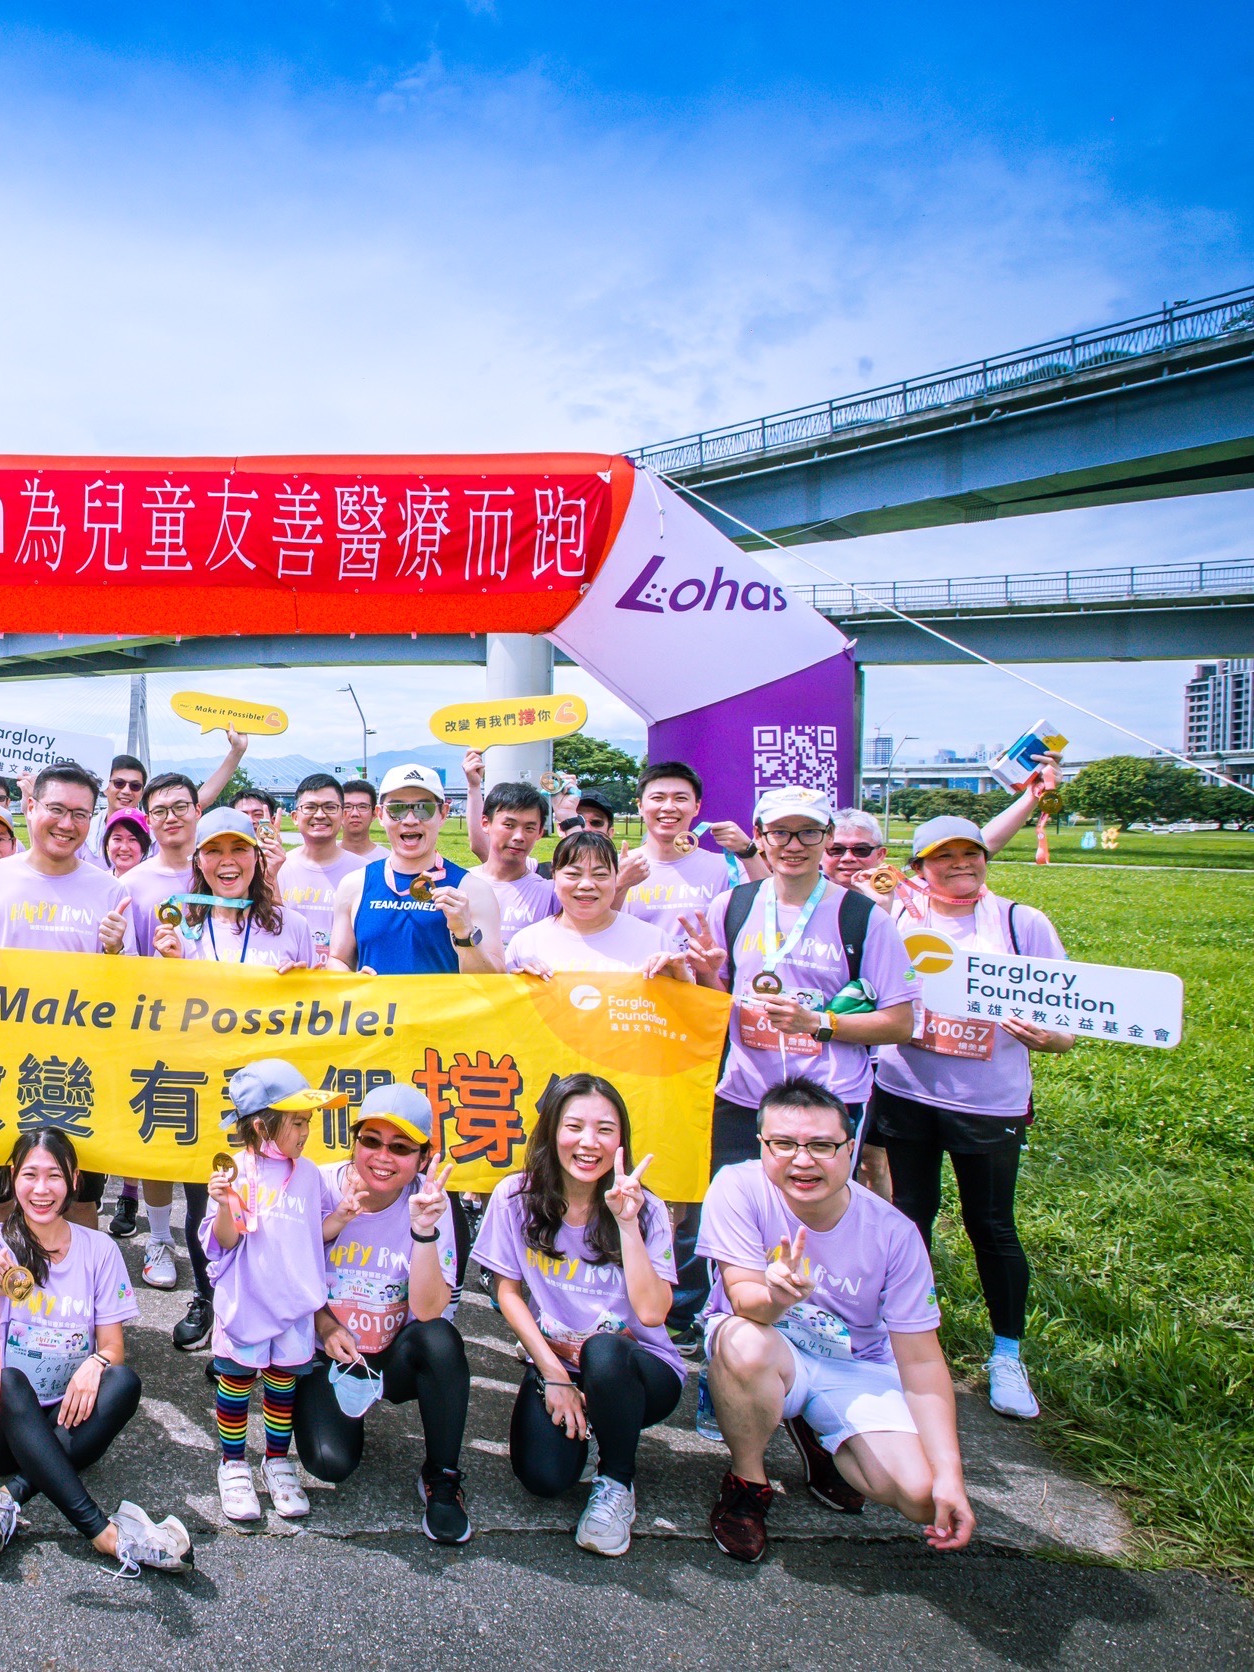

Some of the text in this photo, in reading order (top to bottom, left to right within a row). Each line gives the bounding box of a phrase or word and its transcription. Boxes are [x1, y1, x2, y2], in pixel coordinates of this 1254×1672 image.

[614, 554, 788, 614] Lohas
[194, 704, 217, 715] Make
[219, 707, 226, 716] it
[227, 709, 265, 722] Possible!
[444, 708, 551, 732] 改變 有我們撐你
[10, 900, 58, 924] HAPPY
[967, 956, 1077, 990] Farglory
[607, 995, 656, 1013] Farglory
[966, 977, 1115, 1015] Foundation
[130, 993, 171, 1032] it
[180, 997, 397, 1038] Possible!
[966, 1000, 1171, 1042] 遠雄文教公益基金會
[926, 1019, 990, 1042] 60057
[347, 1311, 405, 1333] 60109
